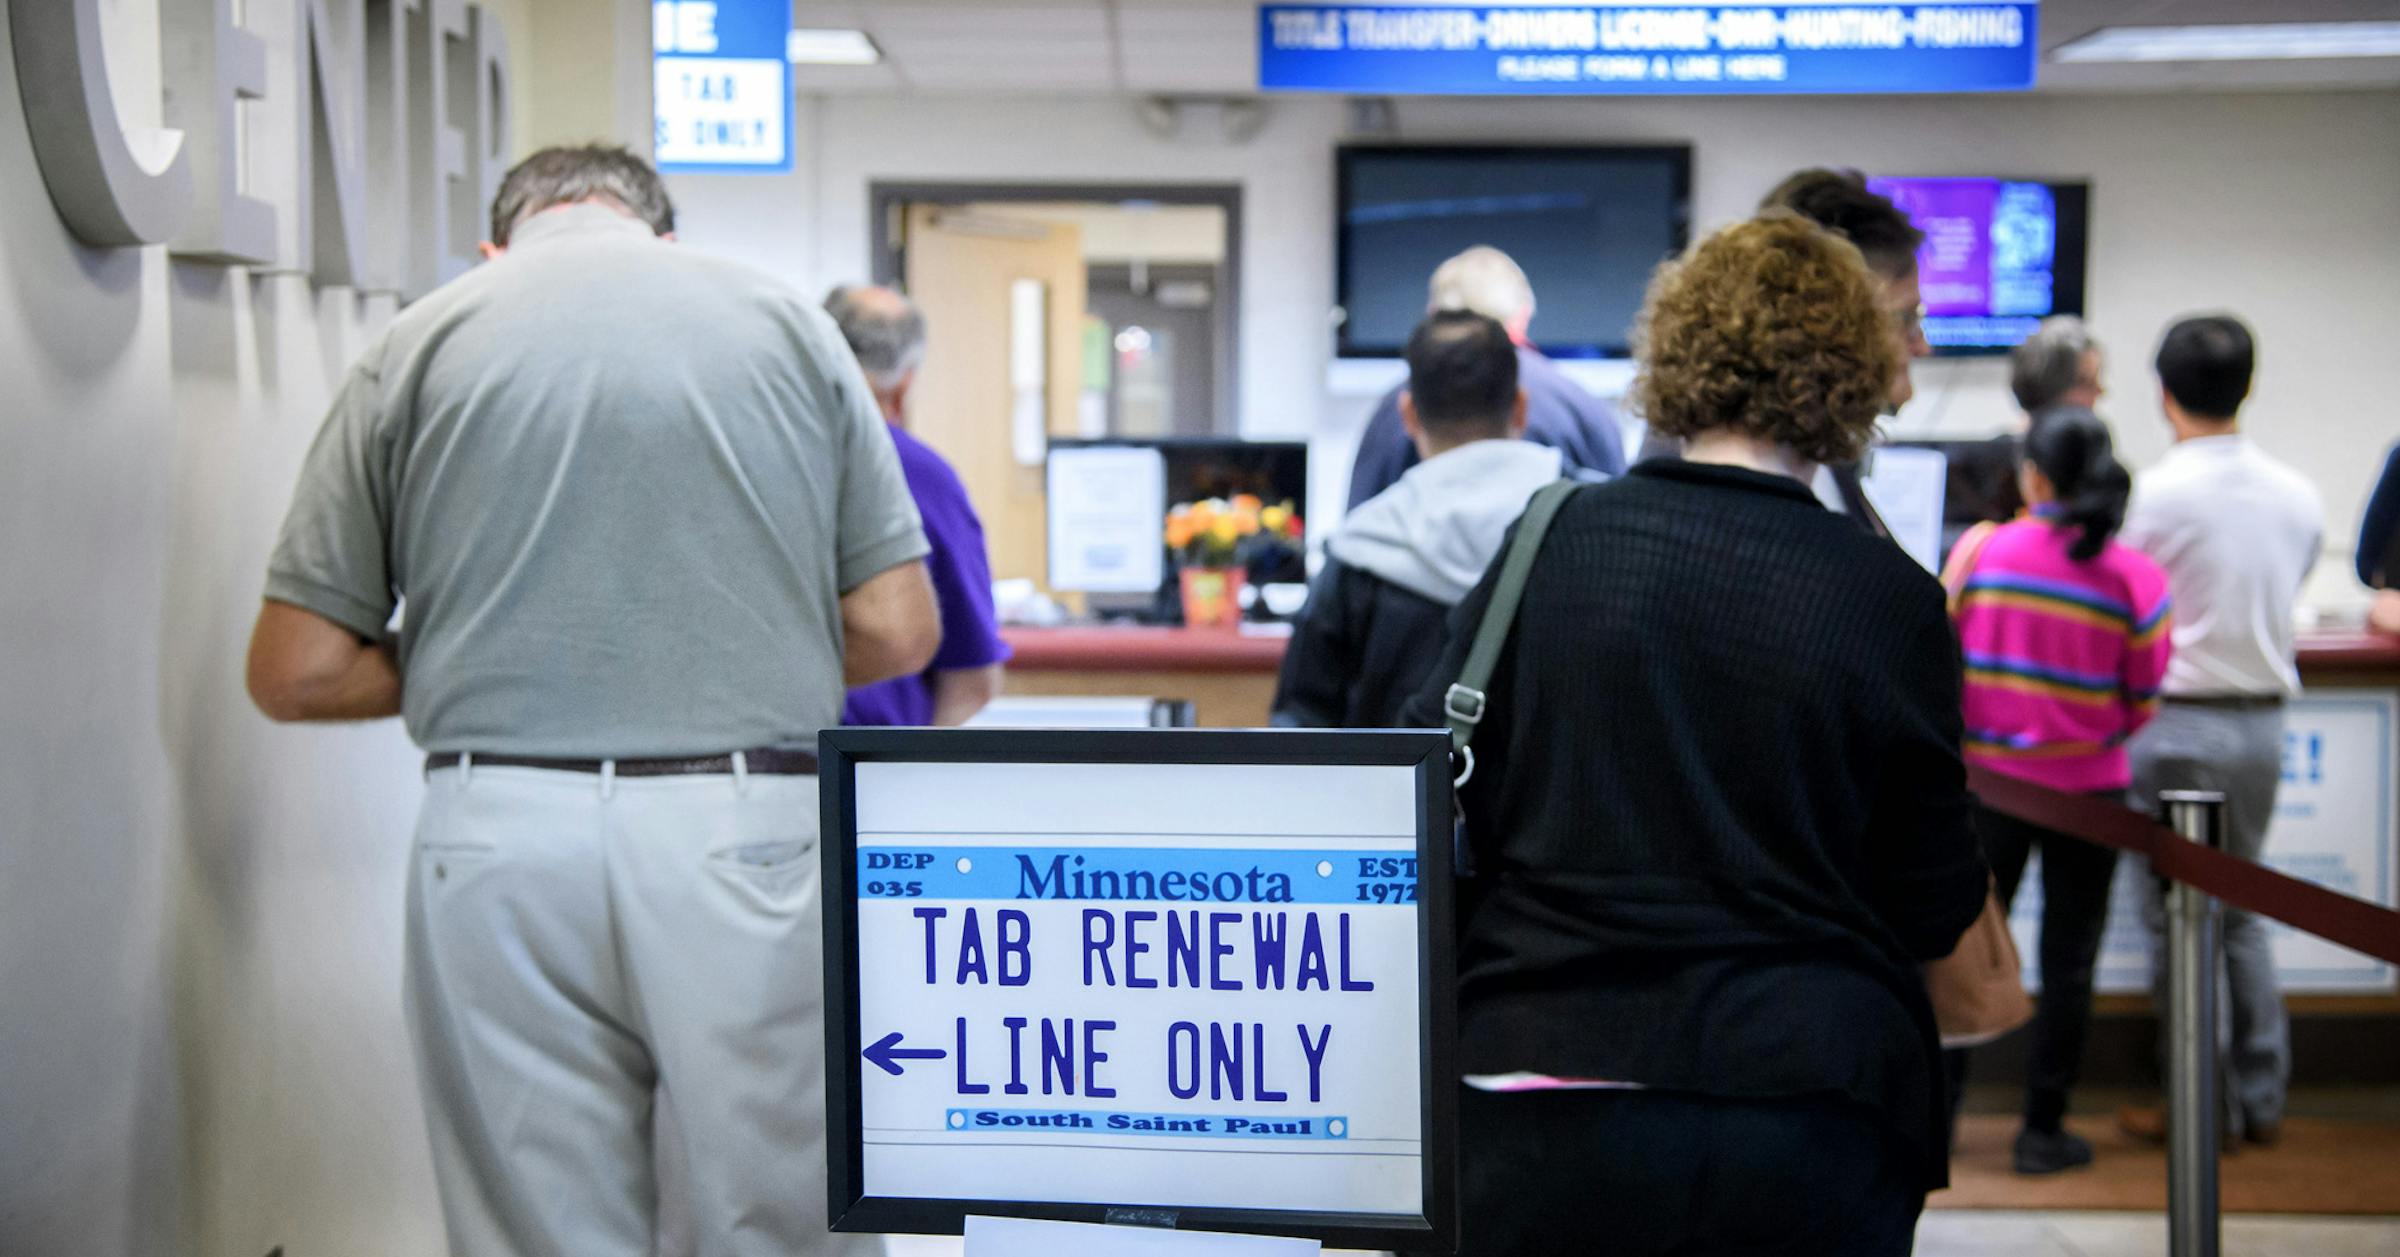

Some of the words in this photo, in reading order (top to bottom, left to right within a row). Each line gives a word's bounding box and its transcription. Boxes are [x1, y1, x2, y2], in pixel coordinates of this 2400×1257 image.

[866, 853, 935, 870] DEP
[1358, 857, 1418, 879] EST
[867, 880, 923, 897] 035
[1015, 854, 1294, 903] Minnesota
[1356, 883, 1418, 905] 1972
[913, 907, 1031, 986] TAB
[1082, 909, 1374, 992] RENEWAL
[956, 1017, 1117, 1098] LINE
[1168, 1021, 1332, 1103] ONLY
[975, 1111, 1093, 1128] South
[1107, 1114, 1211, 1133] Saint
[1224, 1118, 1313, 1135] Paul
